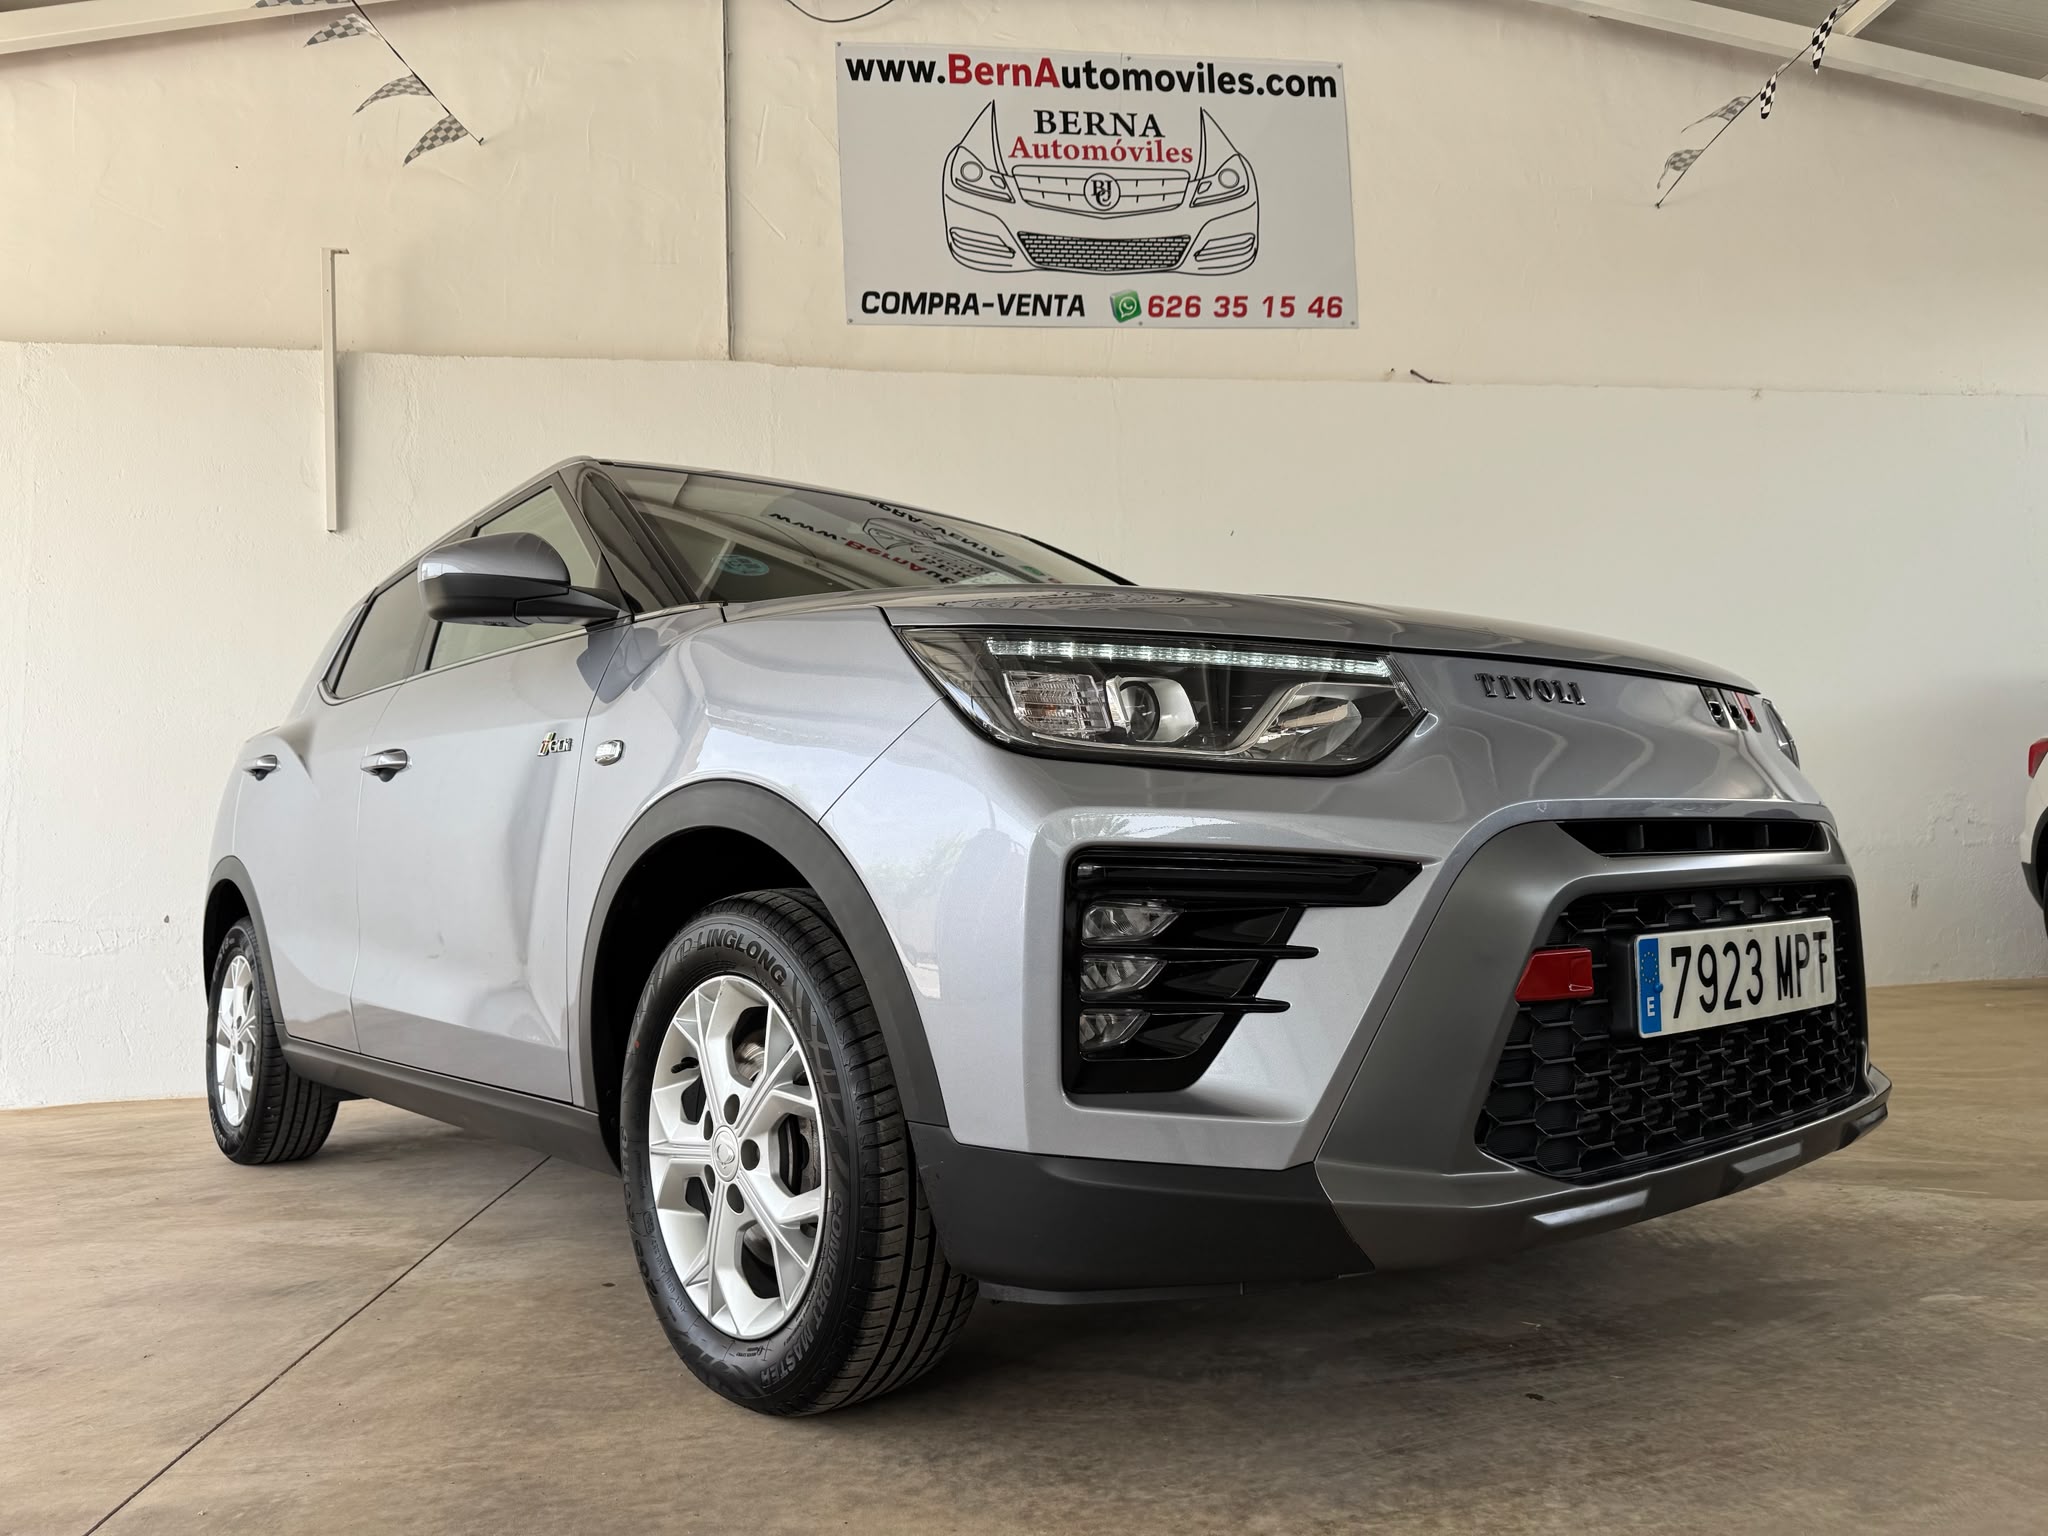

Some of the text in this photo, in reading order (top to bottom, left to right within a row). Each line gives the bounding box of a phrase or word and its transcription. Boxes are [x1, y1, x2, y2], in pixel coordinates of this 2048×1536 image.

[844, 53, 1337, 98] www.BernAutomoviles.com
[1033, 109, 1166, 138] BERNA
[1007, 135, 1194, 164] Automóviles
[861, 290, 1086, 317] COMPRA-VENTA
[1147, 295, 1343, 319] 626 35 15 46
[1474, 672, 1586, 706] TIVOLI
[696, 928, 788, 986] LINGLONG
[1646, 930, 1828, 1020] E 7923 MPT
[815, 1191, 844, 1331] COMFORT
[760, 1323, 816, 1387] MASTER
